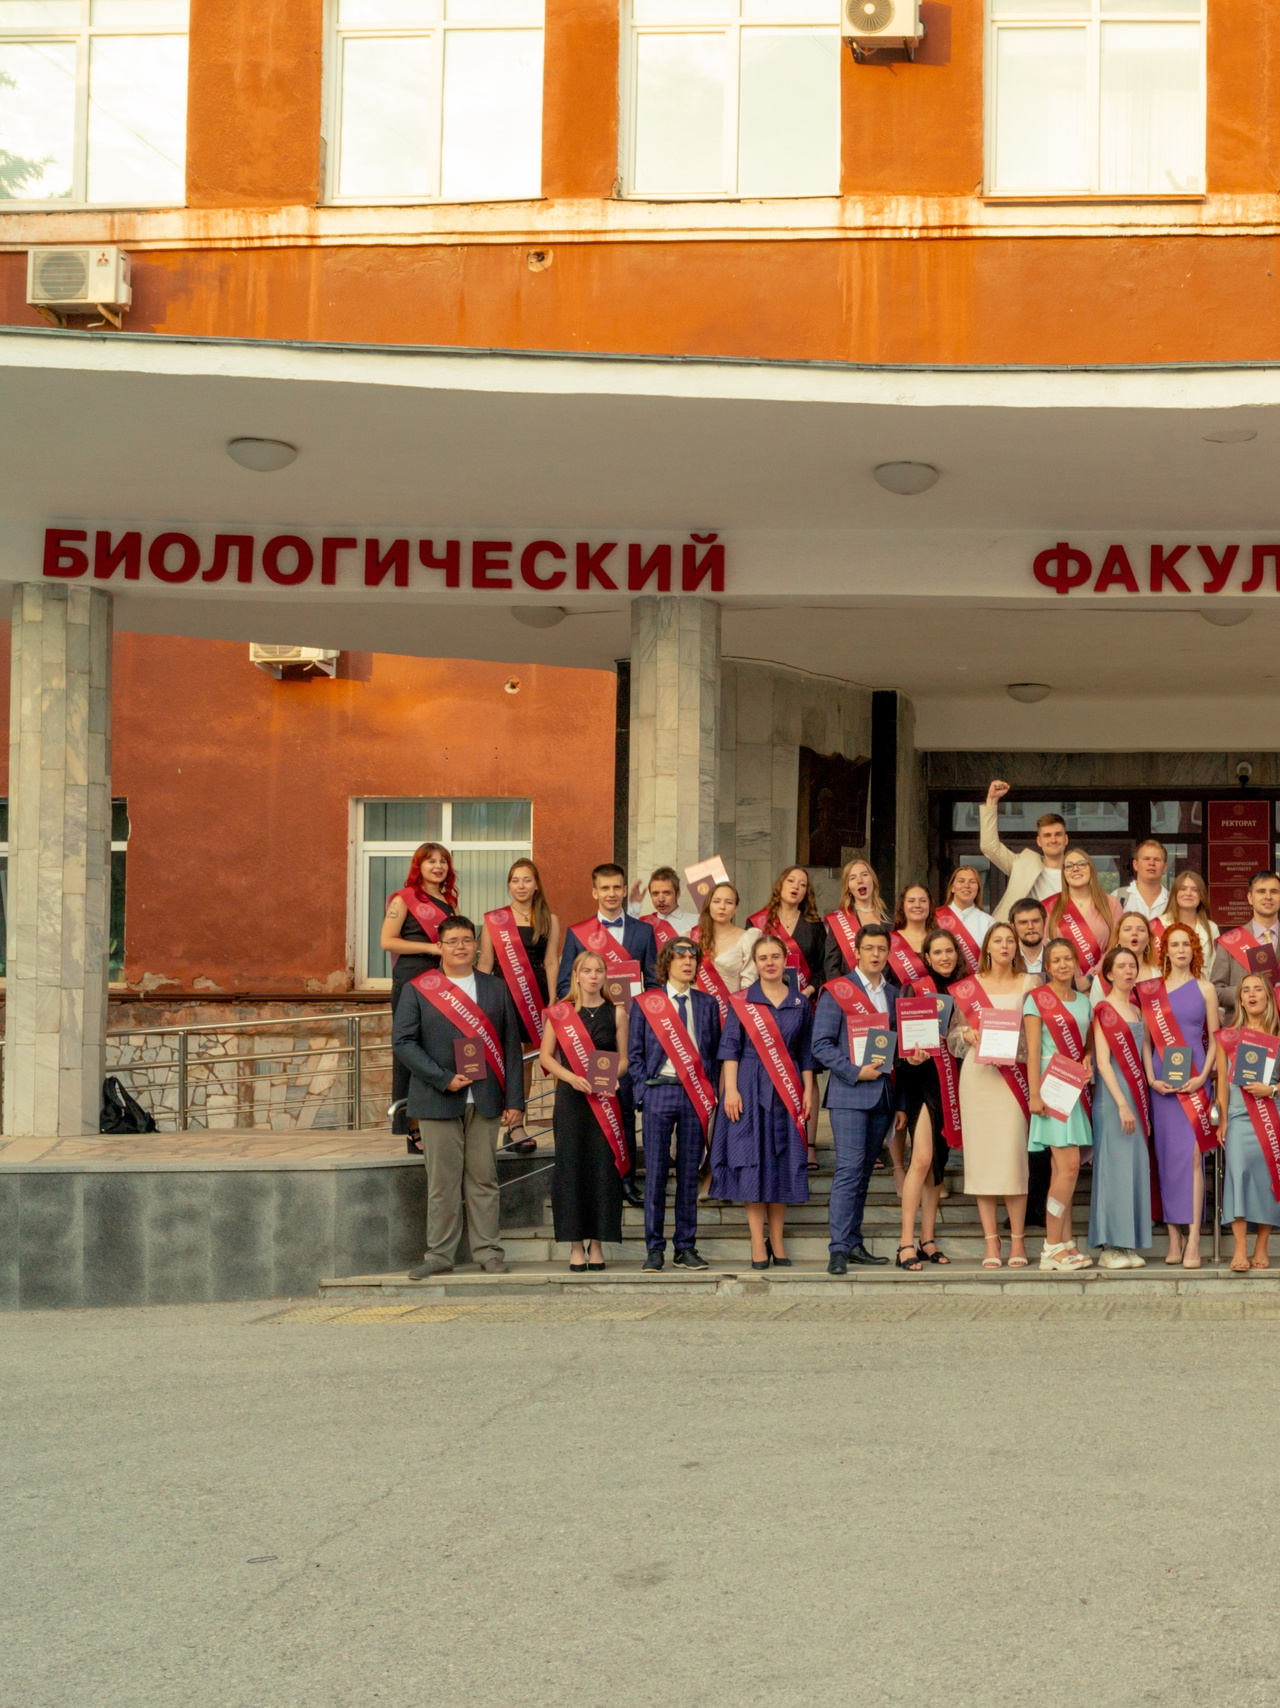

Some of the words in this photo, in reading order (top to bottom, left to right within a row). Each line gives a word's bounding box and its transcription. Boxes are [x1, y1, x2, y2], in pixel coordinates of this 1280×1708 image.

[42, 528, 726, 593] БИОЛОГИЧЕСКИЙ
[499, 930, 522, 978] ЛУЧШИЙ
[1063, 913, 1090, 953] ЛУЧШИЙ
[438, 990, 479, 1029] ЛУЧШИЙ
[1151, 998, 1176, 1047] ЛУЧШИЙ
[660, 1017, 692, 1065] ЛУЧШИЙ
[745, 1003, 775, 1048] ЛУЧШИЙ
[768, 1047, 802, 1116] ВЫПУСКНИК
[1053, 1013, 1081, 1062] ЛУЧШИЙ
[1114, 1031, 1142, 1079] ЛУЧШИЙ
[950, 1107, 961, 1131] 2024
[1197, 1112, 1212, 1136] 2024
